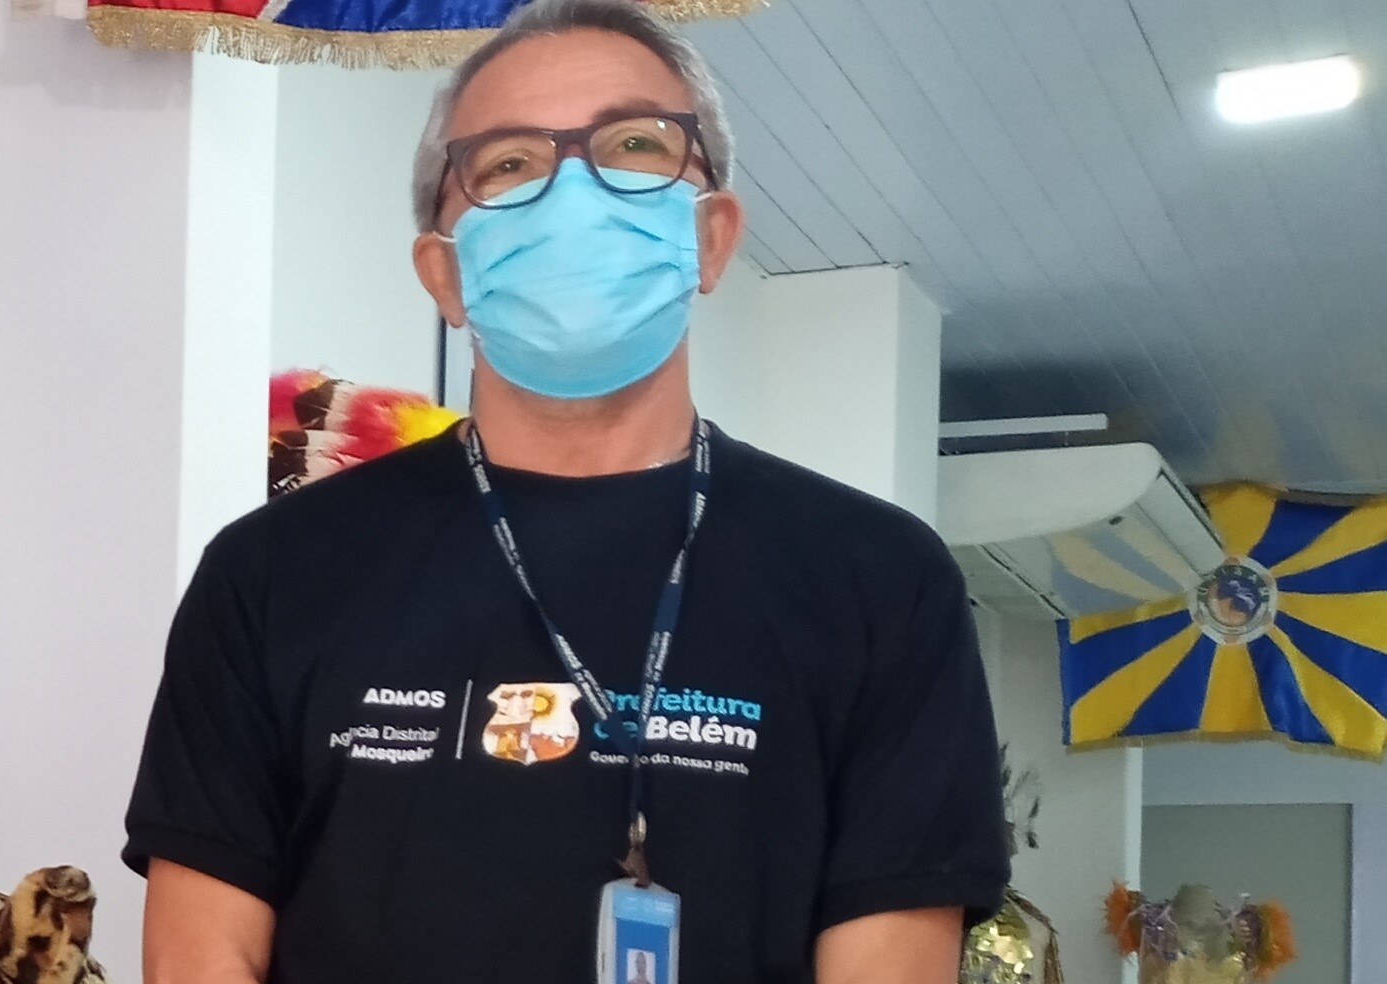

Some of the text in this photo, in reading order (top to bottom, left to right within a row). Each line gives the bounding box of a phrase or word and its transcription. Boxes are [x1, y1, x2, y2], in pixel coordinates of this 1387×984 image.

[363, 687, 447, 709] ADMOS
[646, 715, 757, 750] Belém
[651, 753, 713, 768] da nossa
